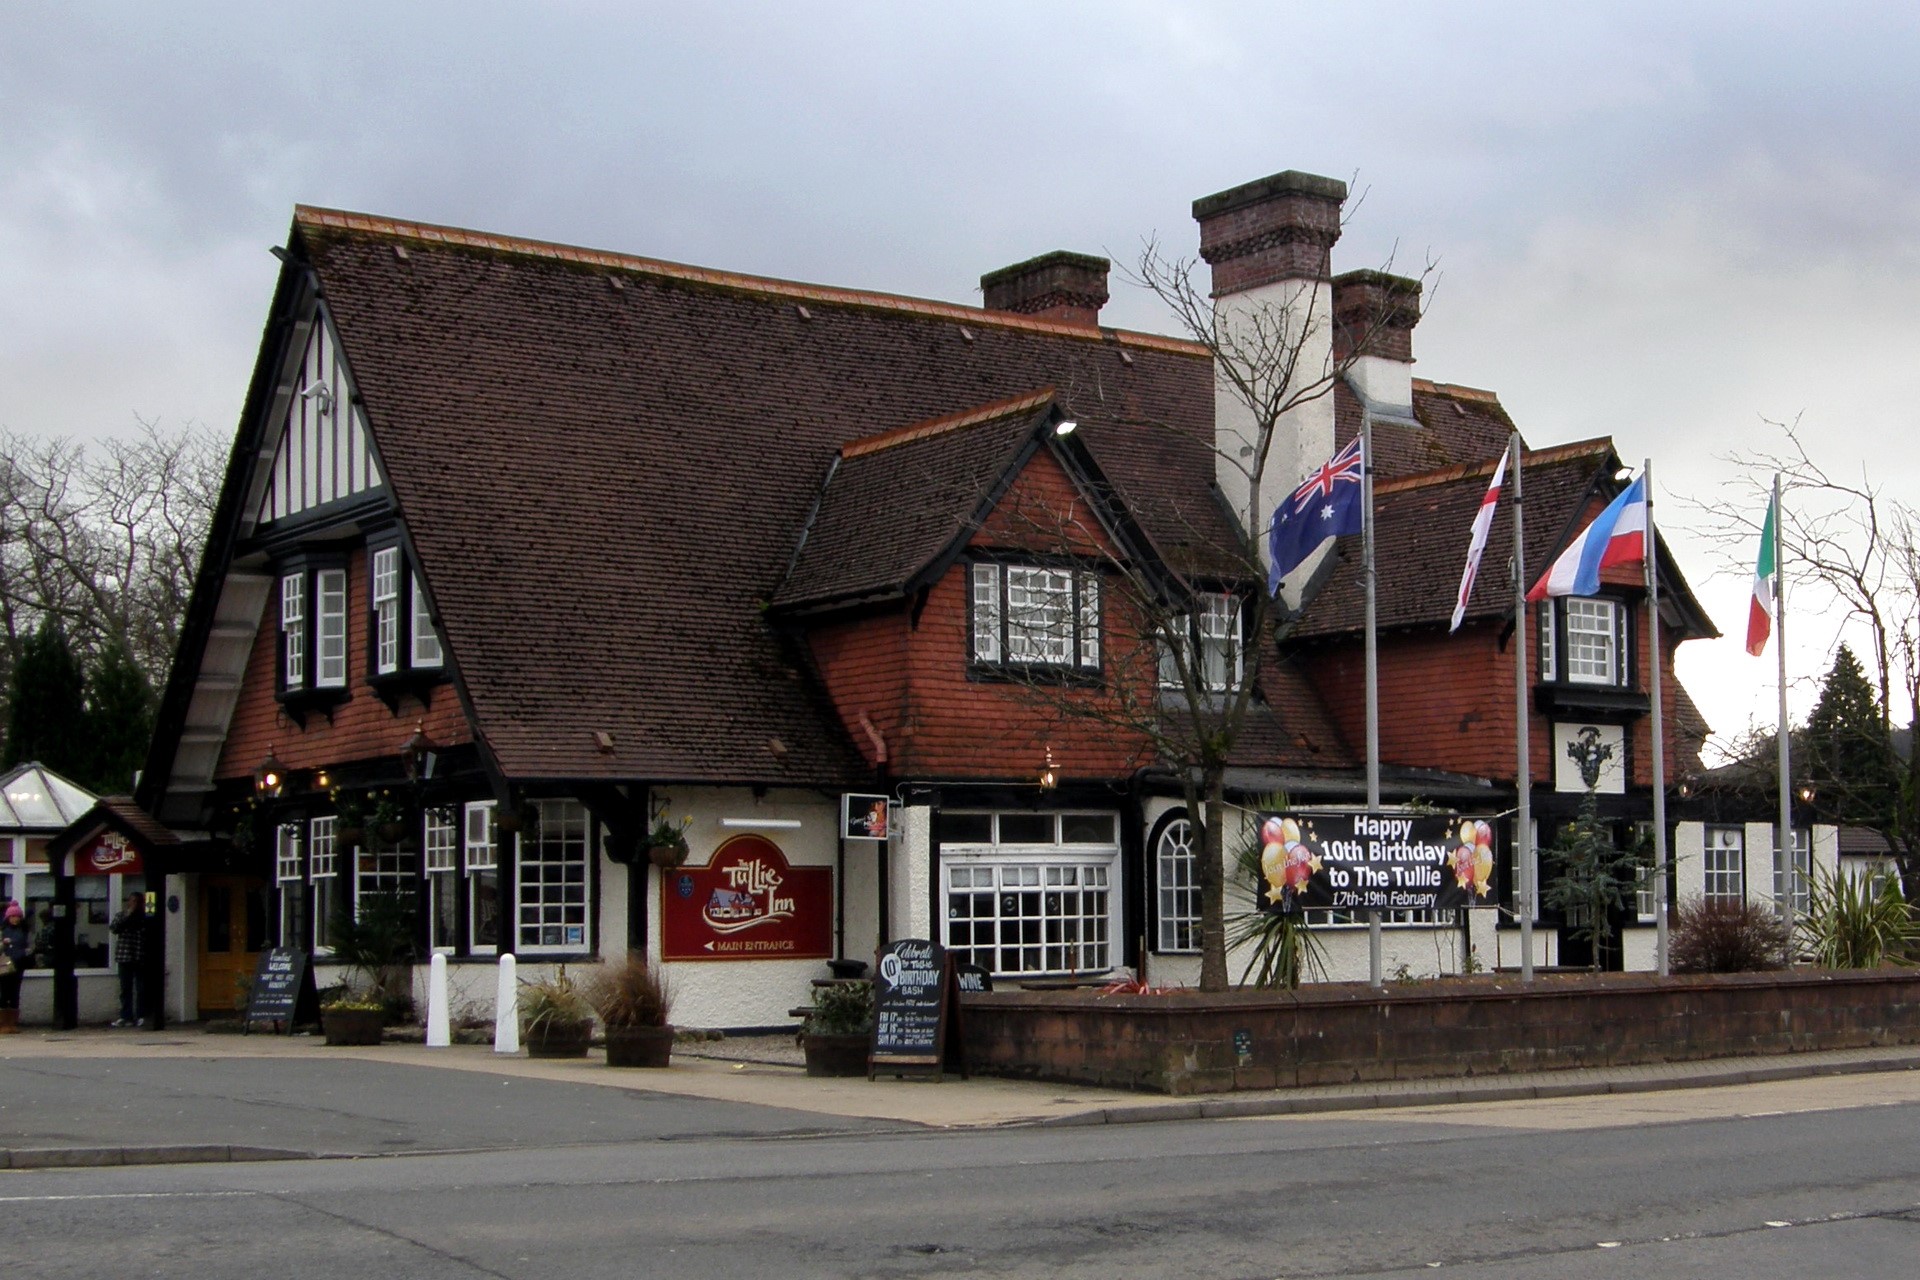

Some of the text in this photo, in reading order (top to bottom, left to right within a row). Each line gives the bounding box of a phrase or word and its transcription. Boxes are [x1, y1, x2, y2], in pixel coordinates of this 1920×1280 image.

[1354, 815, 1412, 840] Happy
[1320, 840, 1445, 865] 10th Birthday
[1329, 866, 1350, 887] to
[1353, 866, 1389, 887] The
[1391, 865, 1442, 887] Tullie
[768, 886, 796, 915] Inn
[1332, 891, 1437, 908] 17th-19th February
[717, 940, 795, 951] MAIN ENTRANCE
[899, 970, 940, 986] BIRTHDAY
[957, 973, 985, 990] WINE
[902, 986, 924, 995] BASH
